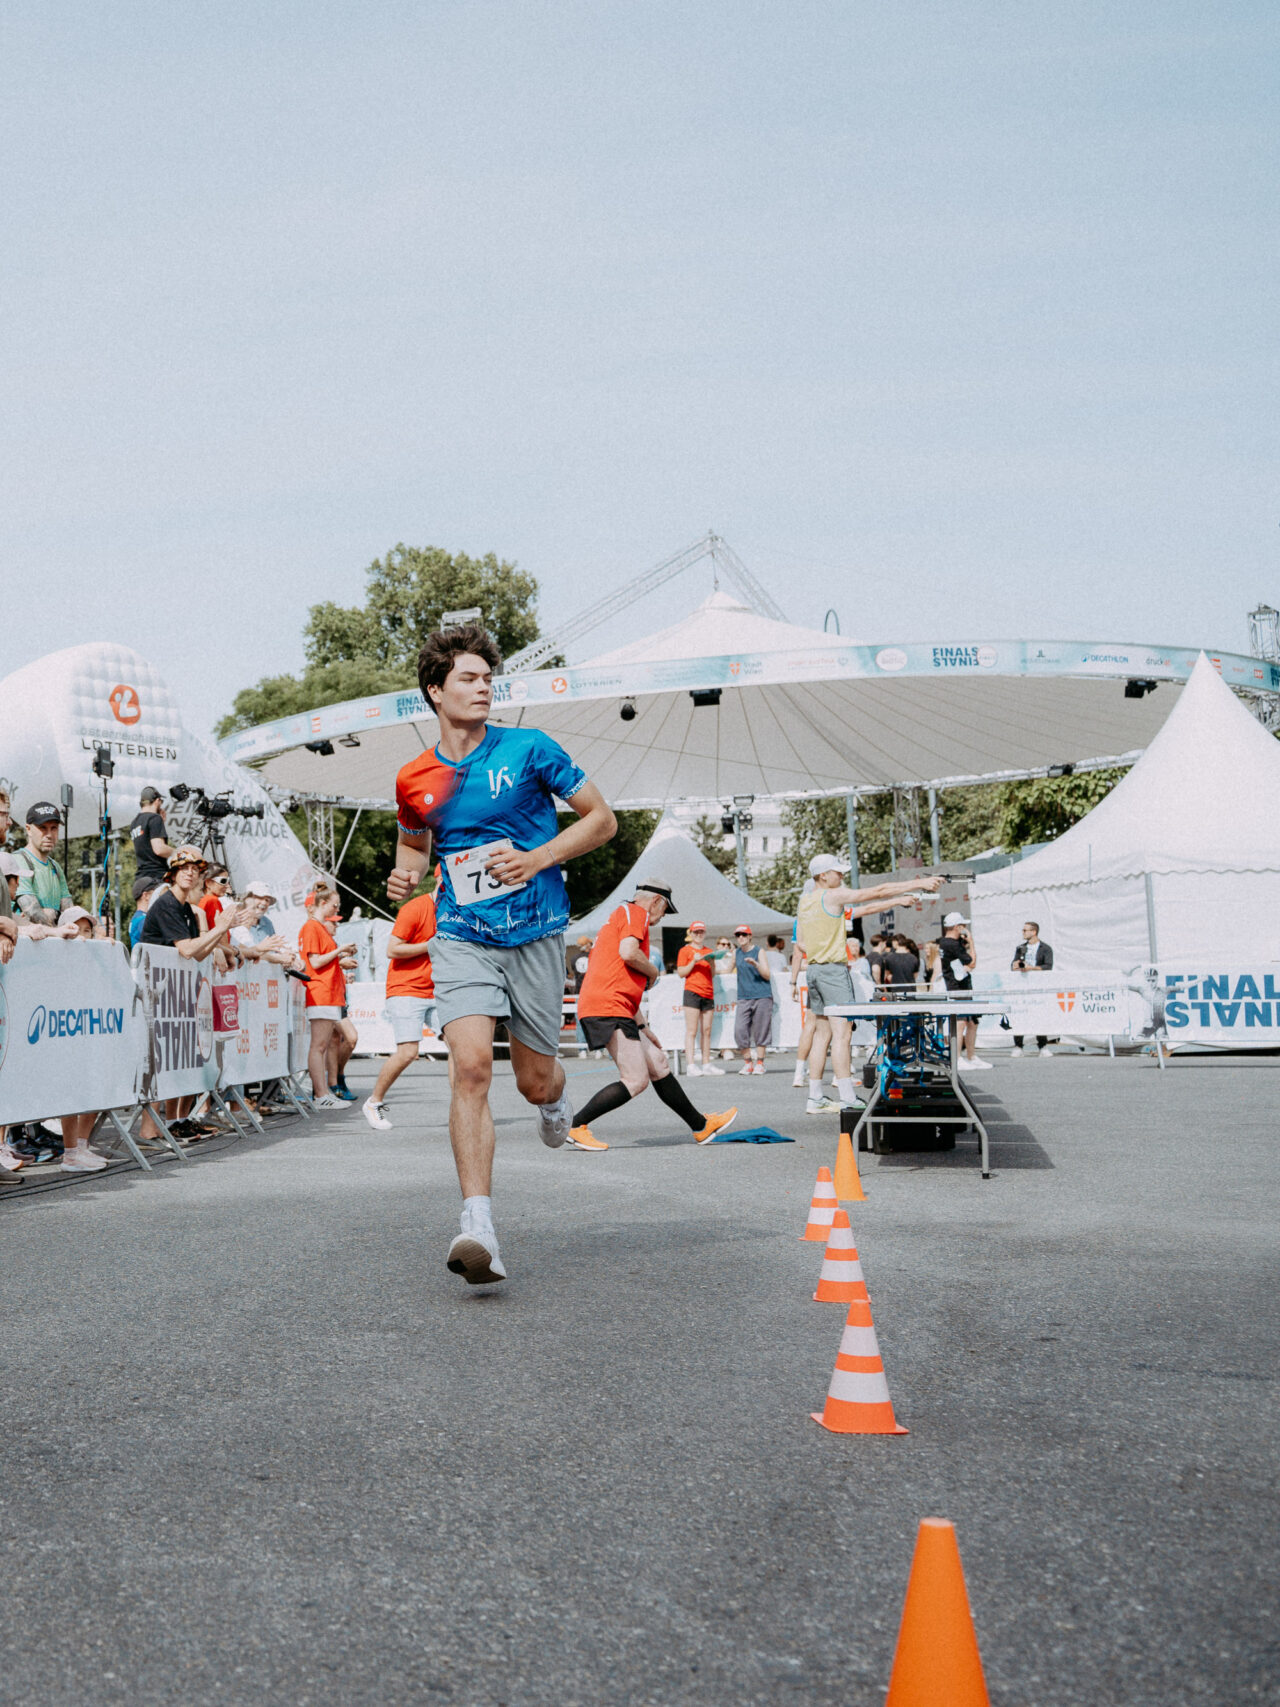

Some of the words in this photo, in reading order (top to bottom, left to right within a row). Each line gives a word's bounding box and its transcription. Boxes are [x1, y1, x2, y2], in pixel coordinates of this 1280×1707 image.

[81, 738, 177, 760] LOTTERIEN
[1081, 990, 1116, 1001] Stadt
[1165, 974, 1280, 1000] FINAL
[1082, 1003, 1116, 1014] Wien
[48, 1008, 124, 1037] DECATHLON
